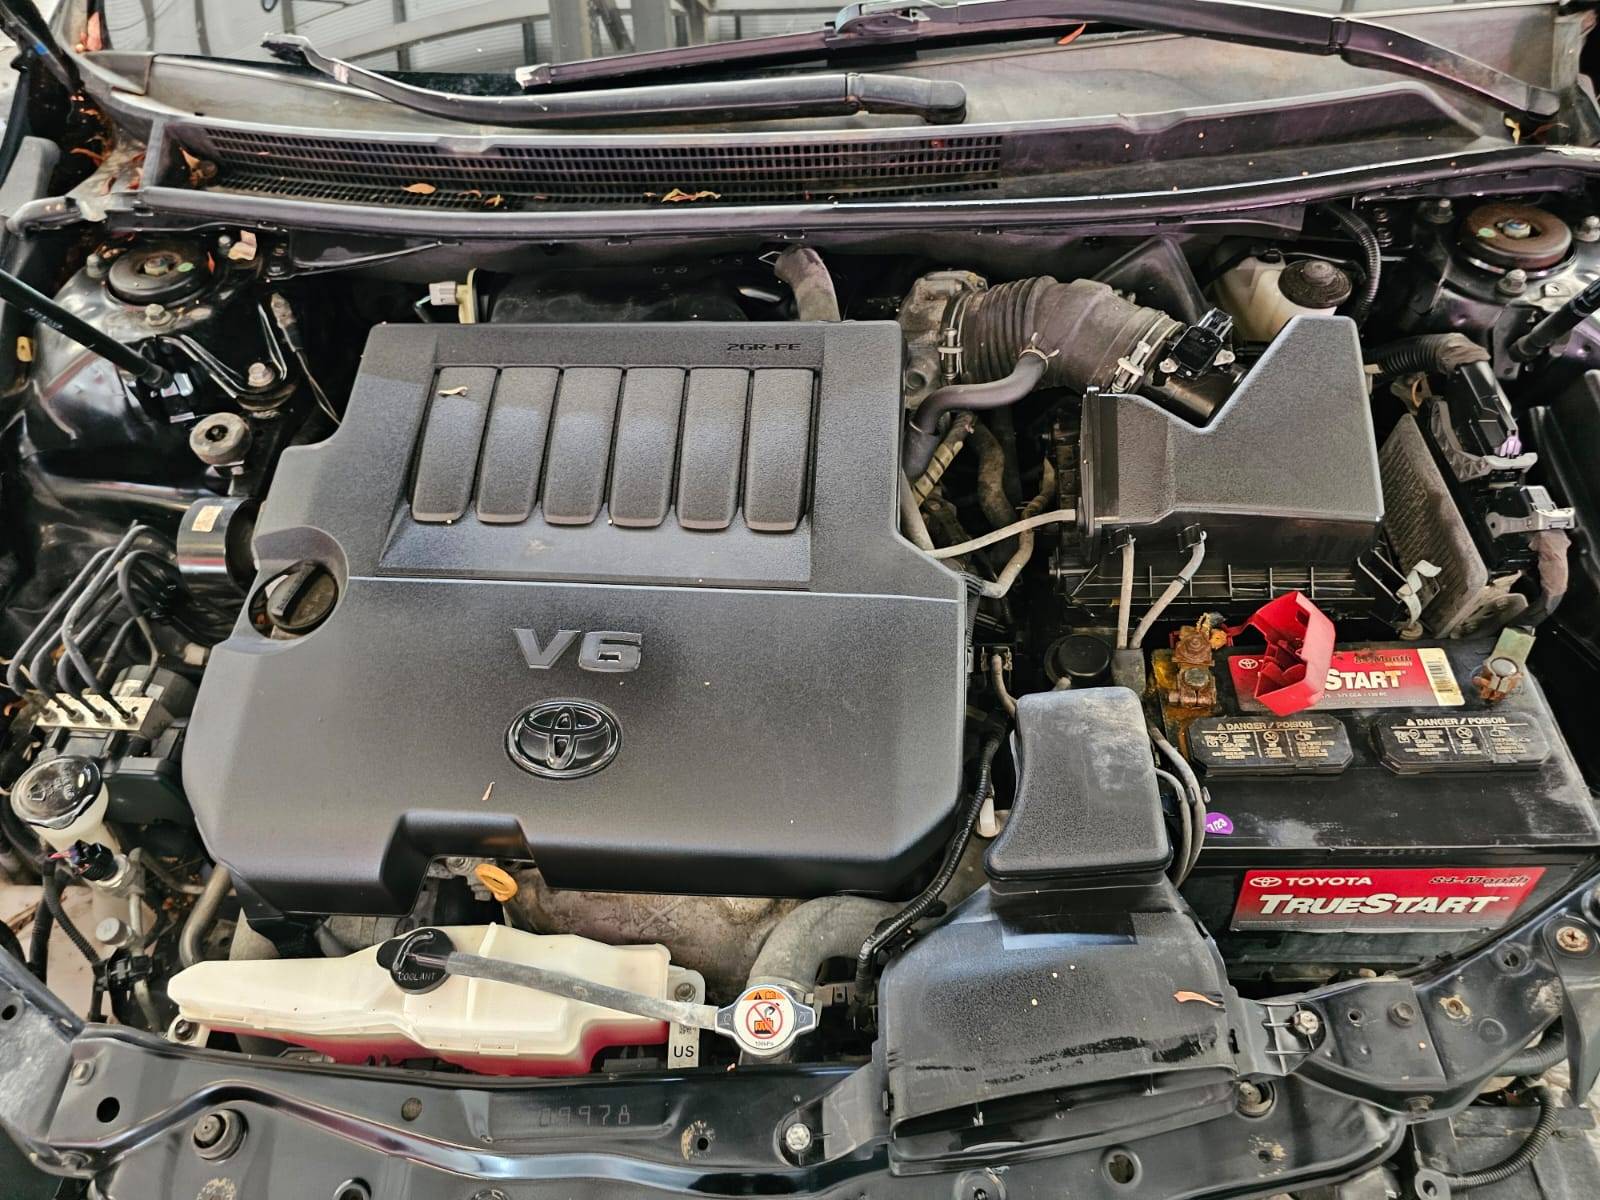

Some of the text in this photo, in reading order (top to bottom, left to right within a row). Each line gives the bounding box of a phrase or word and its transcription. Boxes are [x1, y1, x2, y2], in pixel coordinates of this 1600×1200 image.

[726, 343, 801, 351] 2GR-FE
[513, 628, 642, 672] V6
[1325, 669, 1401, 690] START
[1226, 722, 1267, 730] DANGER
[1276, 721, 1313, 729] POISON
[1416, 718, 1458, 726] DANGER
[1468, 717, 1507, 725] POISON
[1286, 877, 1373, 886] TOYOTA
[1430, 875, 1529, 884] 84-Month
[1260, 893, 1500, 914] TRUESTART
[398, 971, 436, 981] COOLANT
[674, 1046, 694, 1057] US
